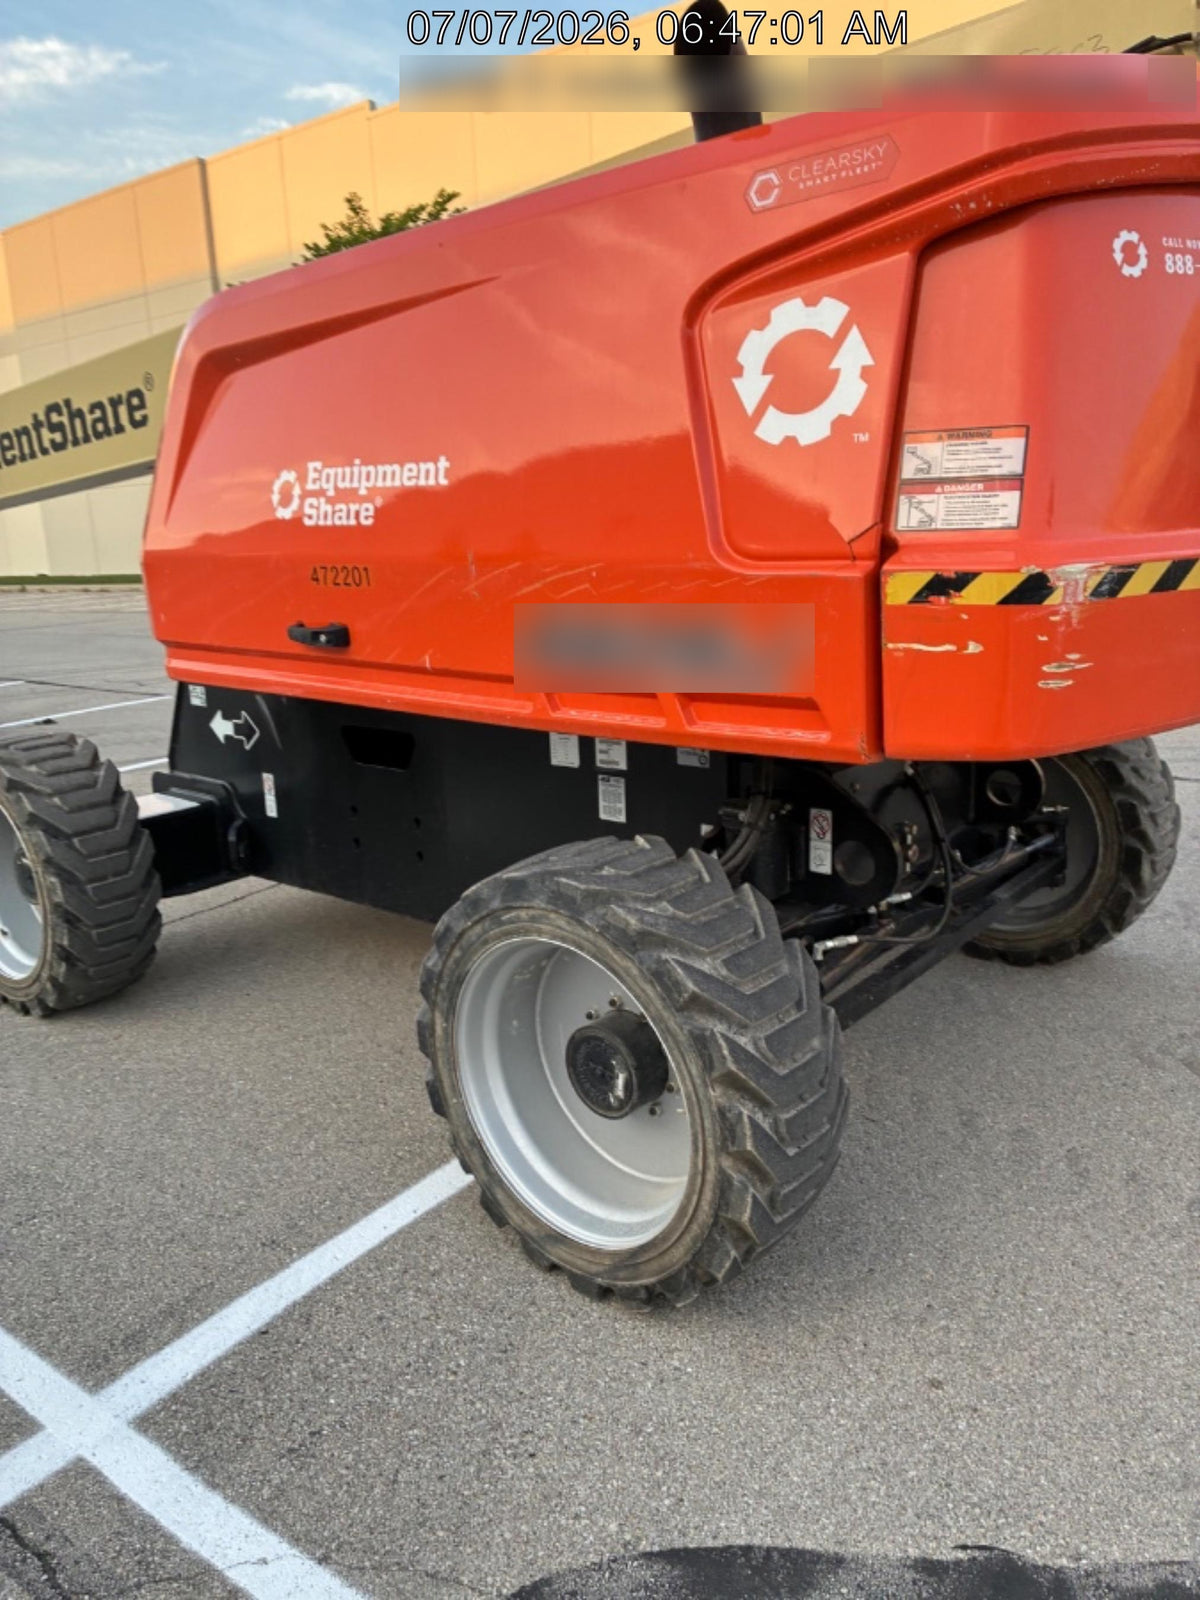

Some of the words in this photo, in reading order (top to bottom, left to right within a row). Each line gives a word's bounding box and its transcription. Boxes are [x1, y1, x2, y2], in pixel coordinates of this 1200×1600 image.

[788, 142, 887, 181] CLEARSKY
[1162, 236, 1184, 248] CALL
[0, 387, 149, 470] entShare
[306, 456, 450, 496] Equipment
[310, 566, 371, 587] 472201
